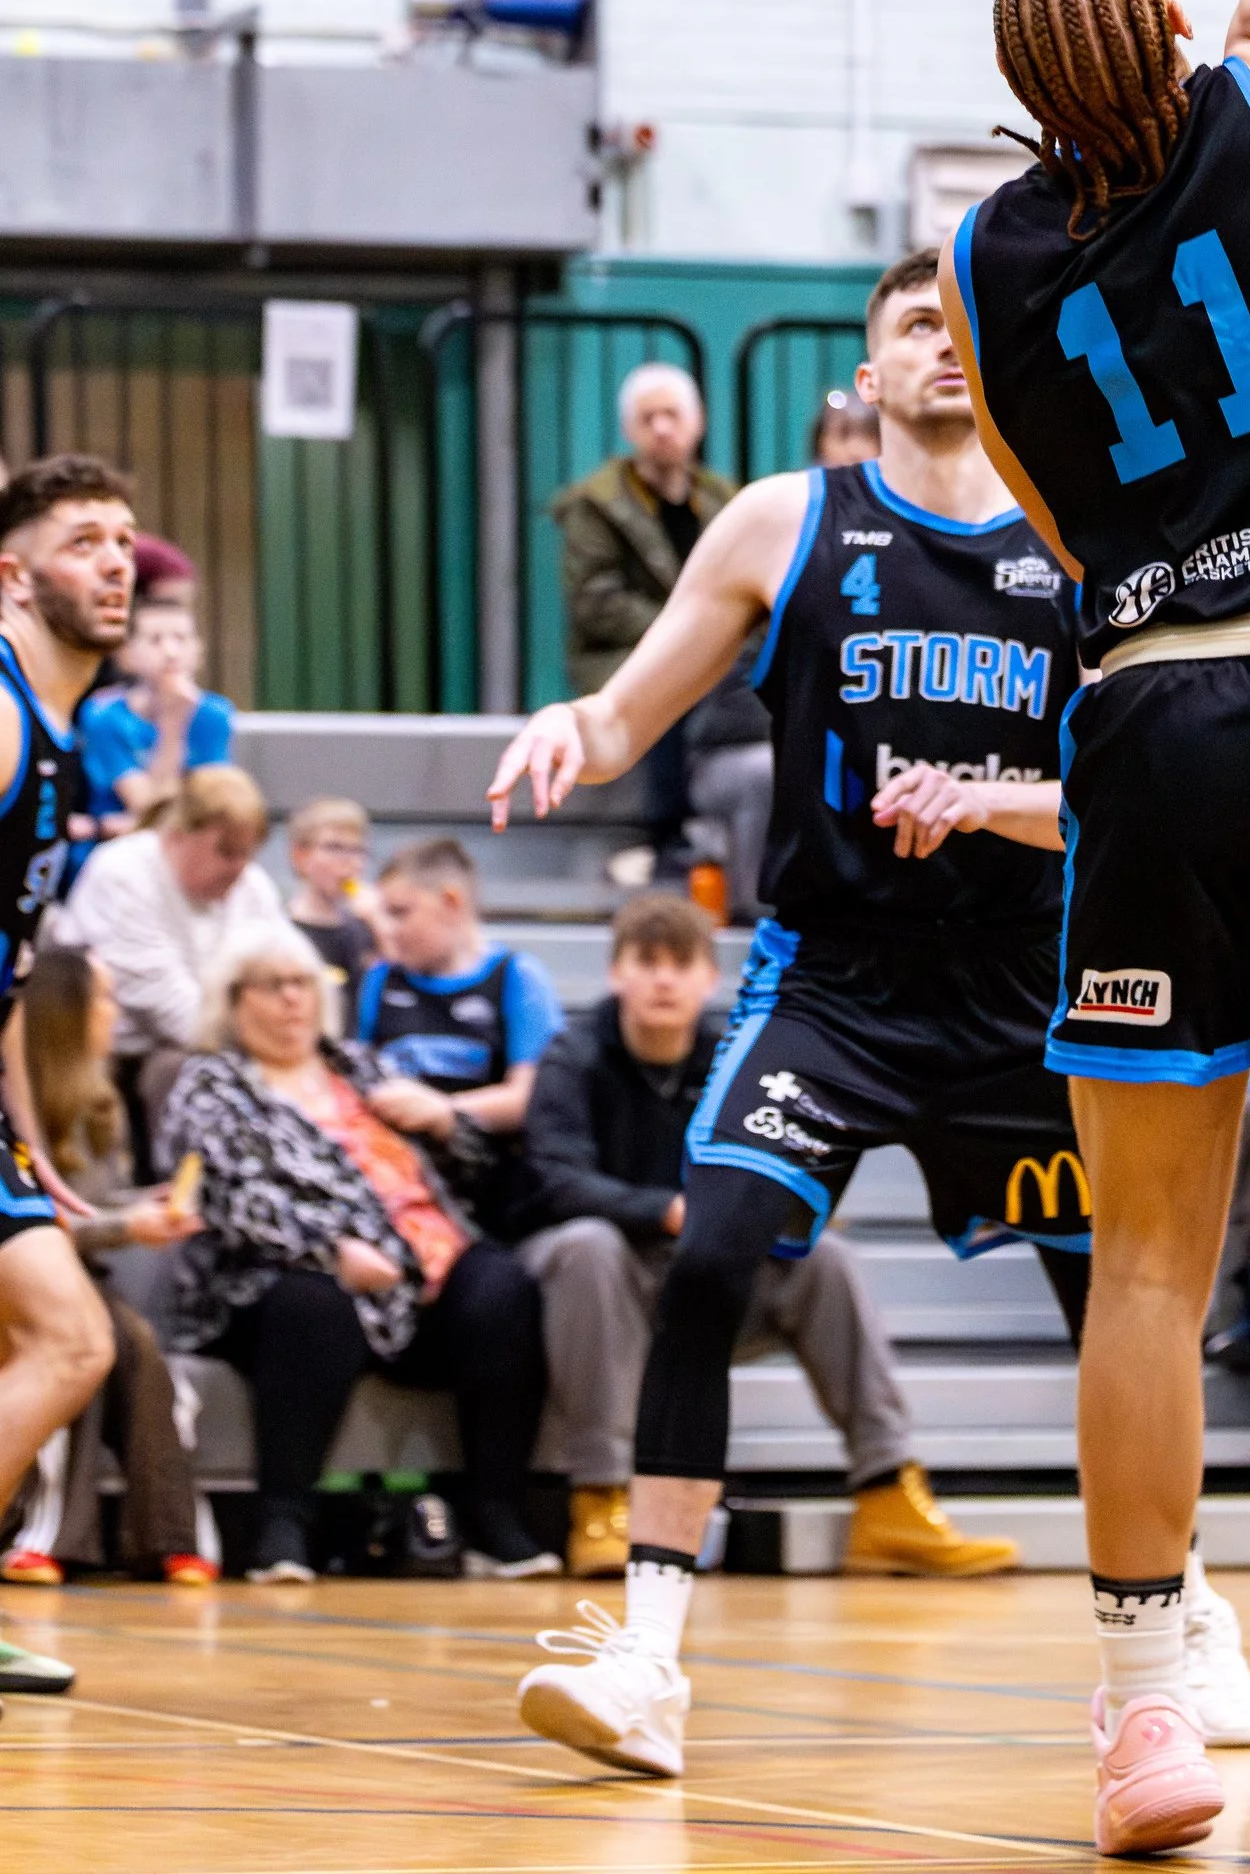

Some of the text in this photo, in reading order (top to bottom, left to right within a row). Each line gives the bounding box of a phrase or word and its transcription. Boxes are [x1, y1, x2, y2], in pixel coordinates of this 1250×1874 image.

[840, 553, 880, 616] 4
[840, 629, 1051, 720] STORM
[1081, 979, 1160, 1007] LYNCH
